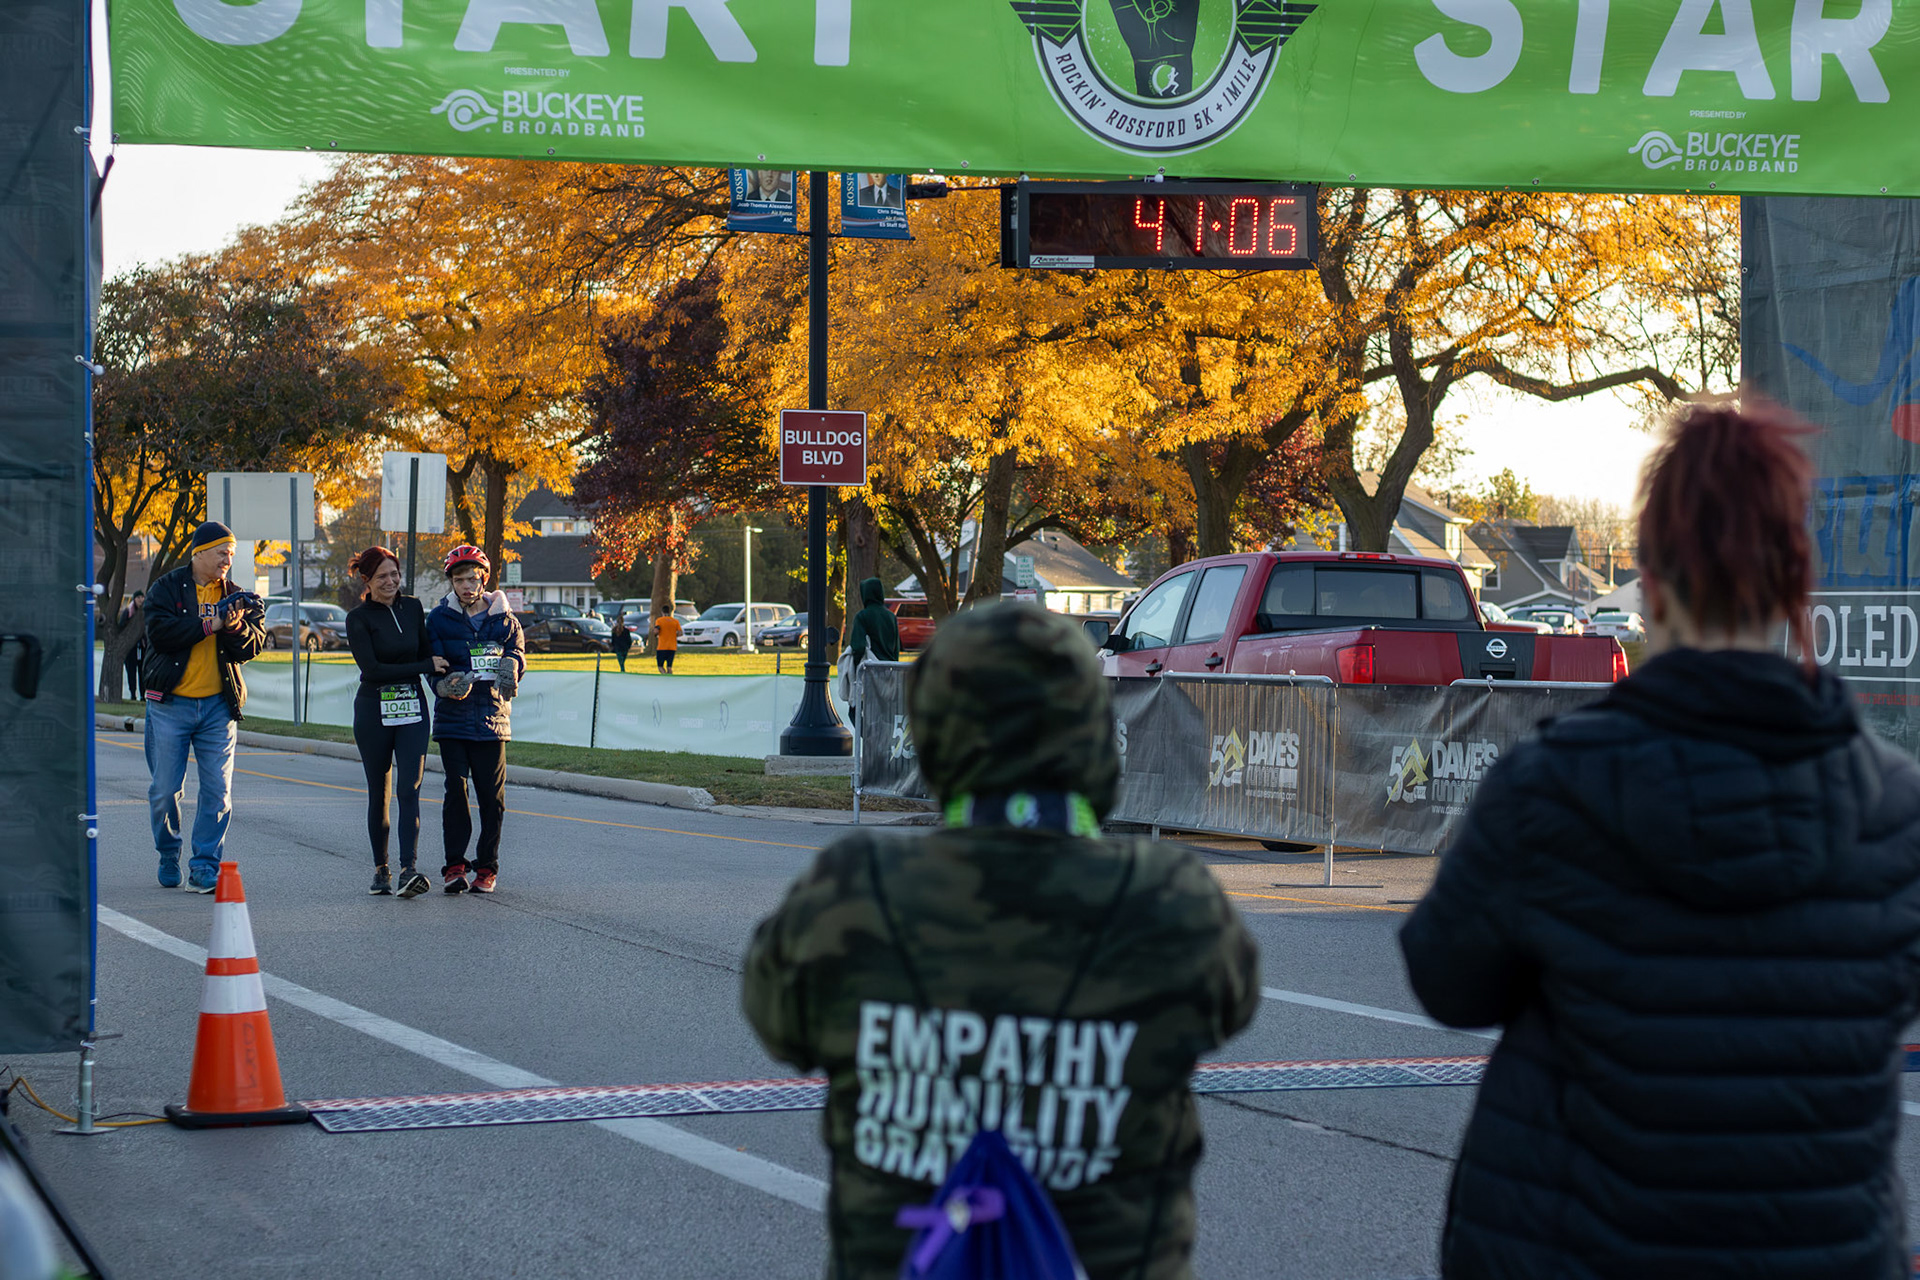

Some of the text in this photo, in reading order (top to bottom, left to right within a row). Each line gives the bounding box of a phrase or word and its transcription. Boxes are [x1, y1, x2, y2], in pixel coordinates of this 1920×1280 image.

[504, 66, 570, 77] PRESENTED BY
[502, 90, 645, 122] BUCKEYE
[1689, 109, 1747, 119] PRESENTED BY
[502, 120, 645, 138] BROADBAND
[1105, 108, 1186, 138] ROSSFORD
[1194, 107, 1214, 130] 5K
[1686, 131, 1801, 159] BUCKEYE
[1684, 158, 1798, 173] BROADBAND
[785, 430, 862, 446] BULLDOG
[802, 450, 844, 465] BLVD
[1798, 604, 1919, 668] OLED
[473, 657, 498, 668] 1042
[384, 702, 411, 713] 1041
[856, 999, 1139, 1090] EMPATHY
[856, 1067, 1132, 1150] HUMILITY
